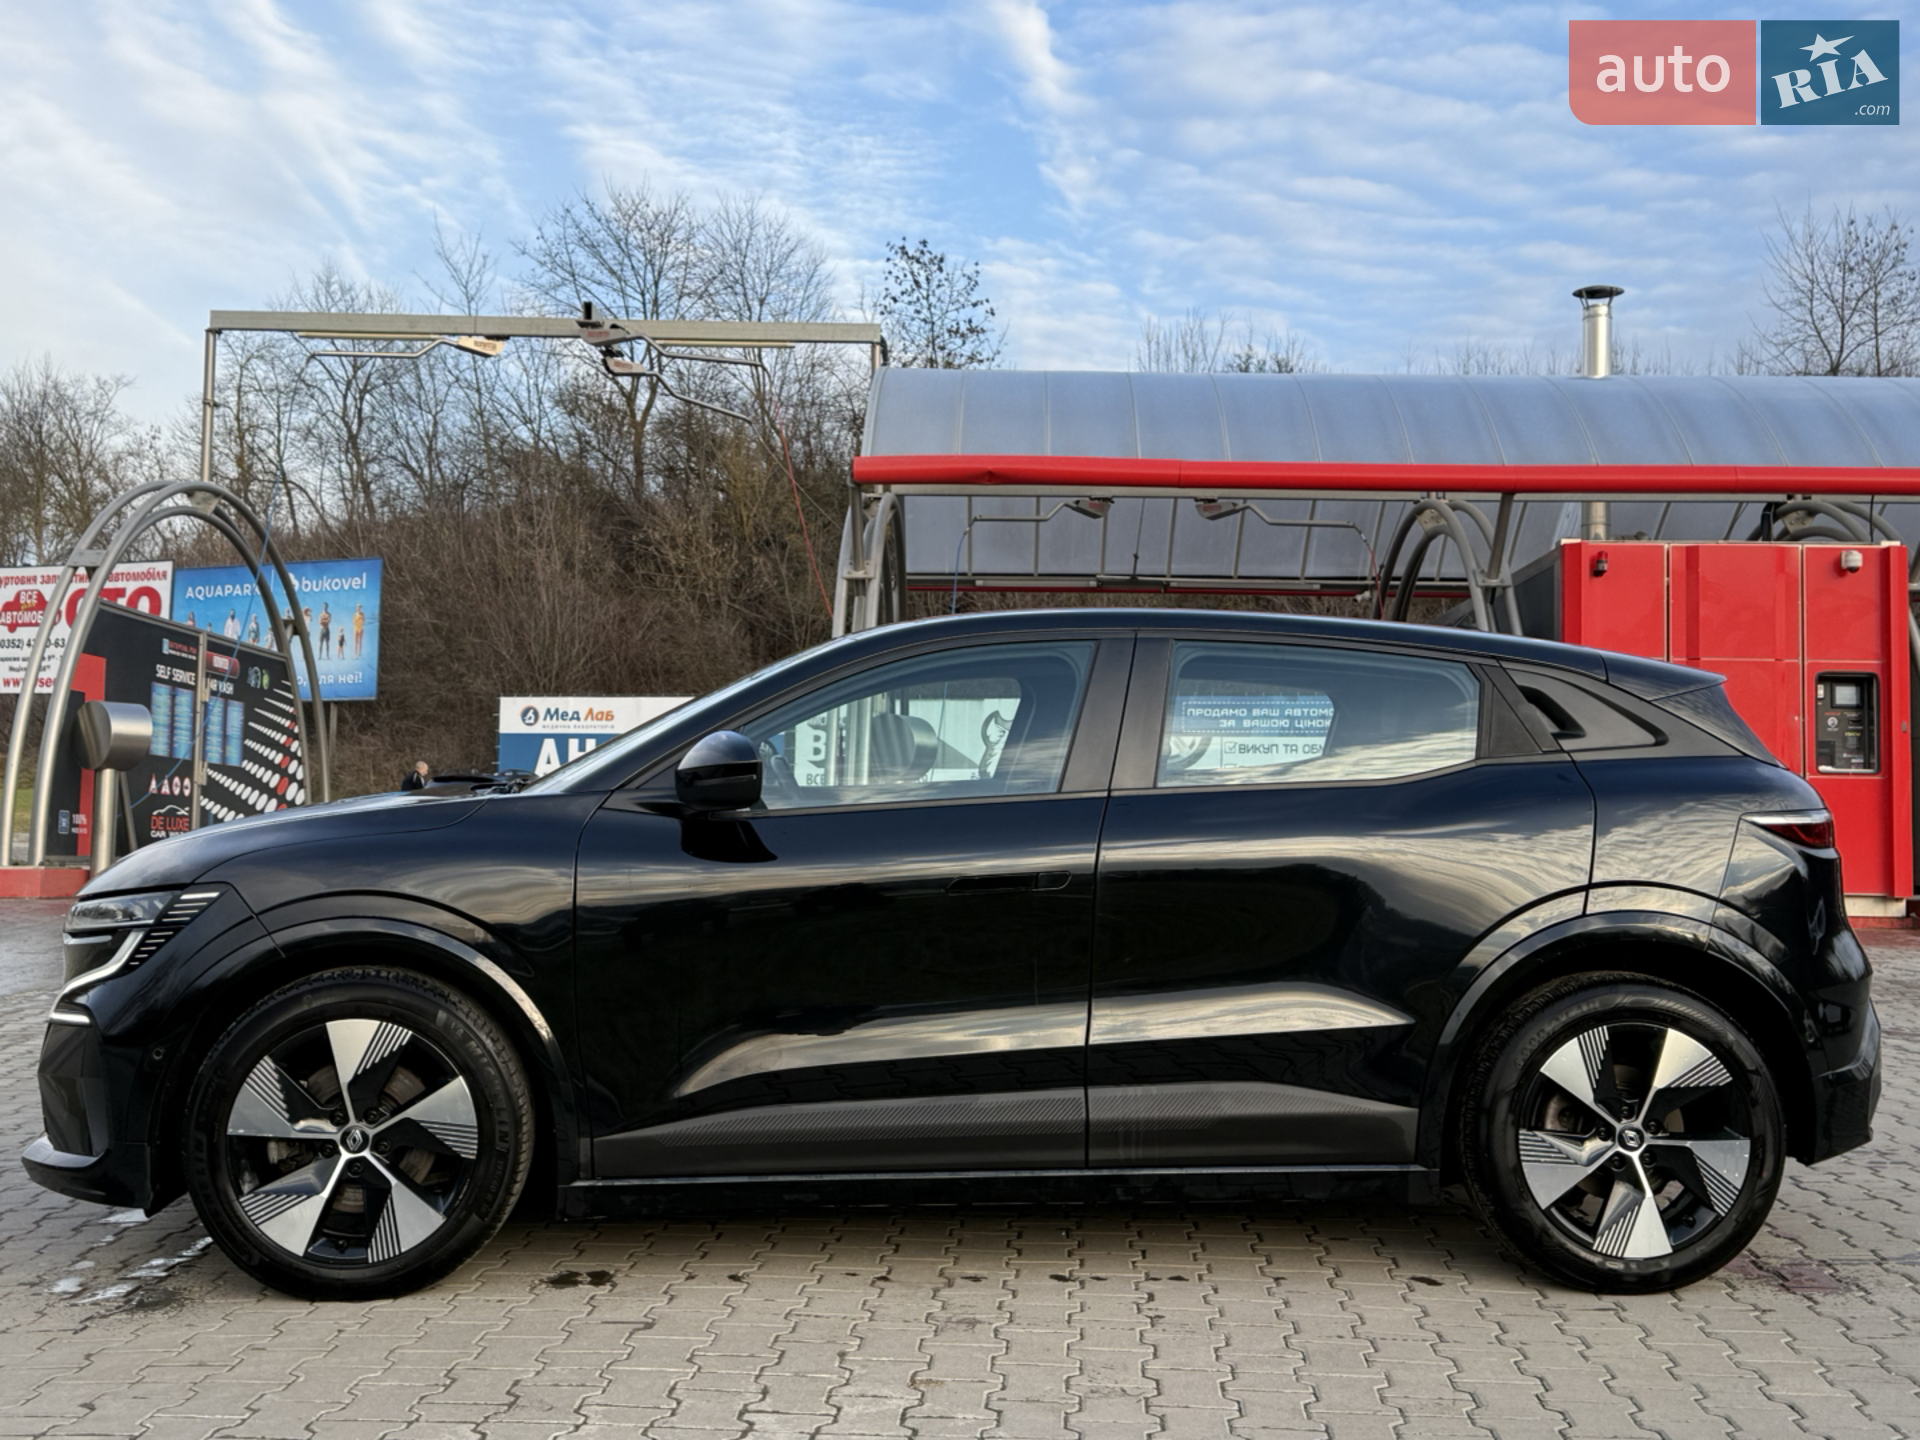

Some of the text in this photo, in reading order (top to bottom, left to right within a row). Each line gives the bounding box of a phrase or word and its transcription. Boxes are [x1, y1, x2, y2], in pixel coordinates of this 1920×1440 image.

[301, 572, 367, 593] bukovel
[543, 707, 614, 722] Мед Лаб
[1187, 708, 1247, 718] ПРОДАМО
[1252, 708, 1279, 717] ВАШ
[1219, 719, 1236, 728] ЗА
[1243, 719, 1290, 728] ВАШОЮ
[1238, 744, 1279, 754] ВИКУП
[1282, 744, 1299, 754] ТА
[150, 815, 190, 832] DE LUXE
[150, 830, 166, 838] CAR
